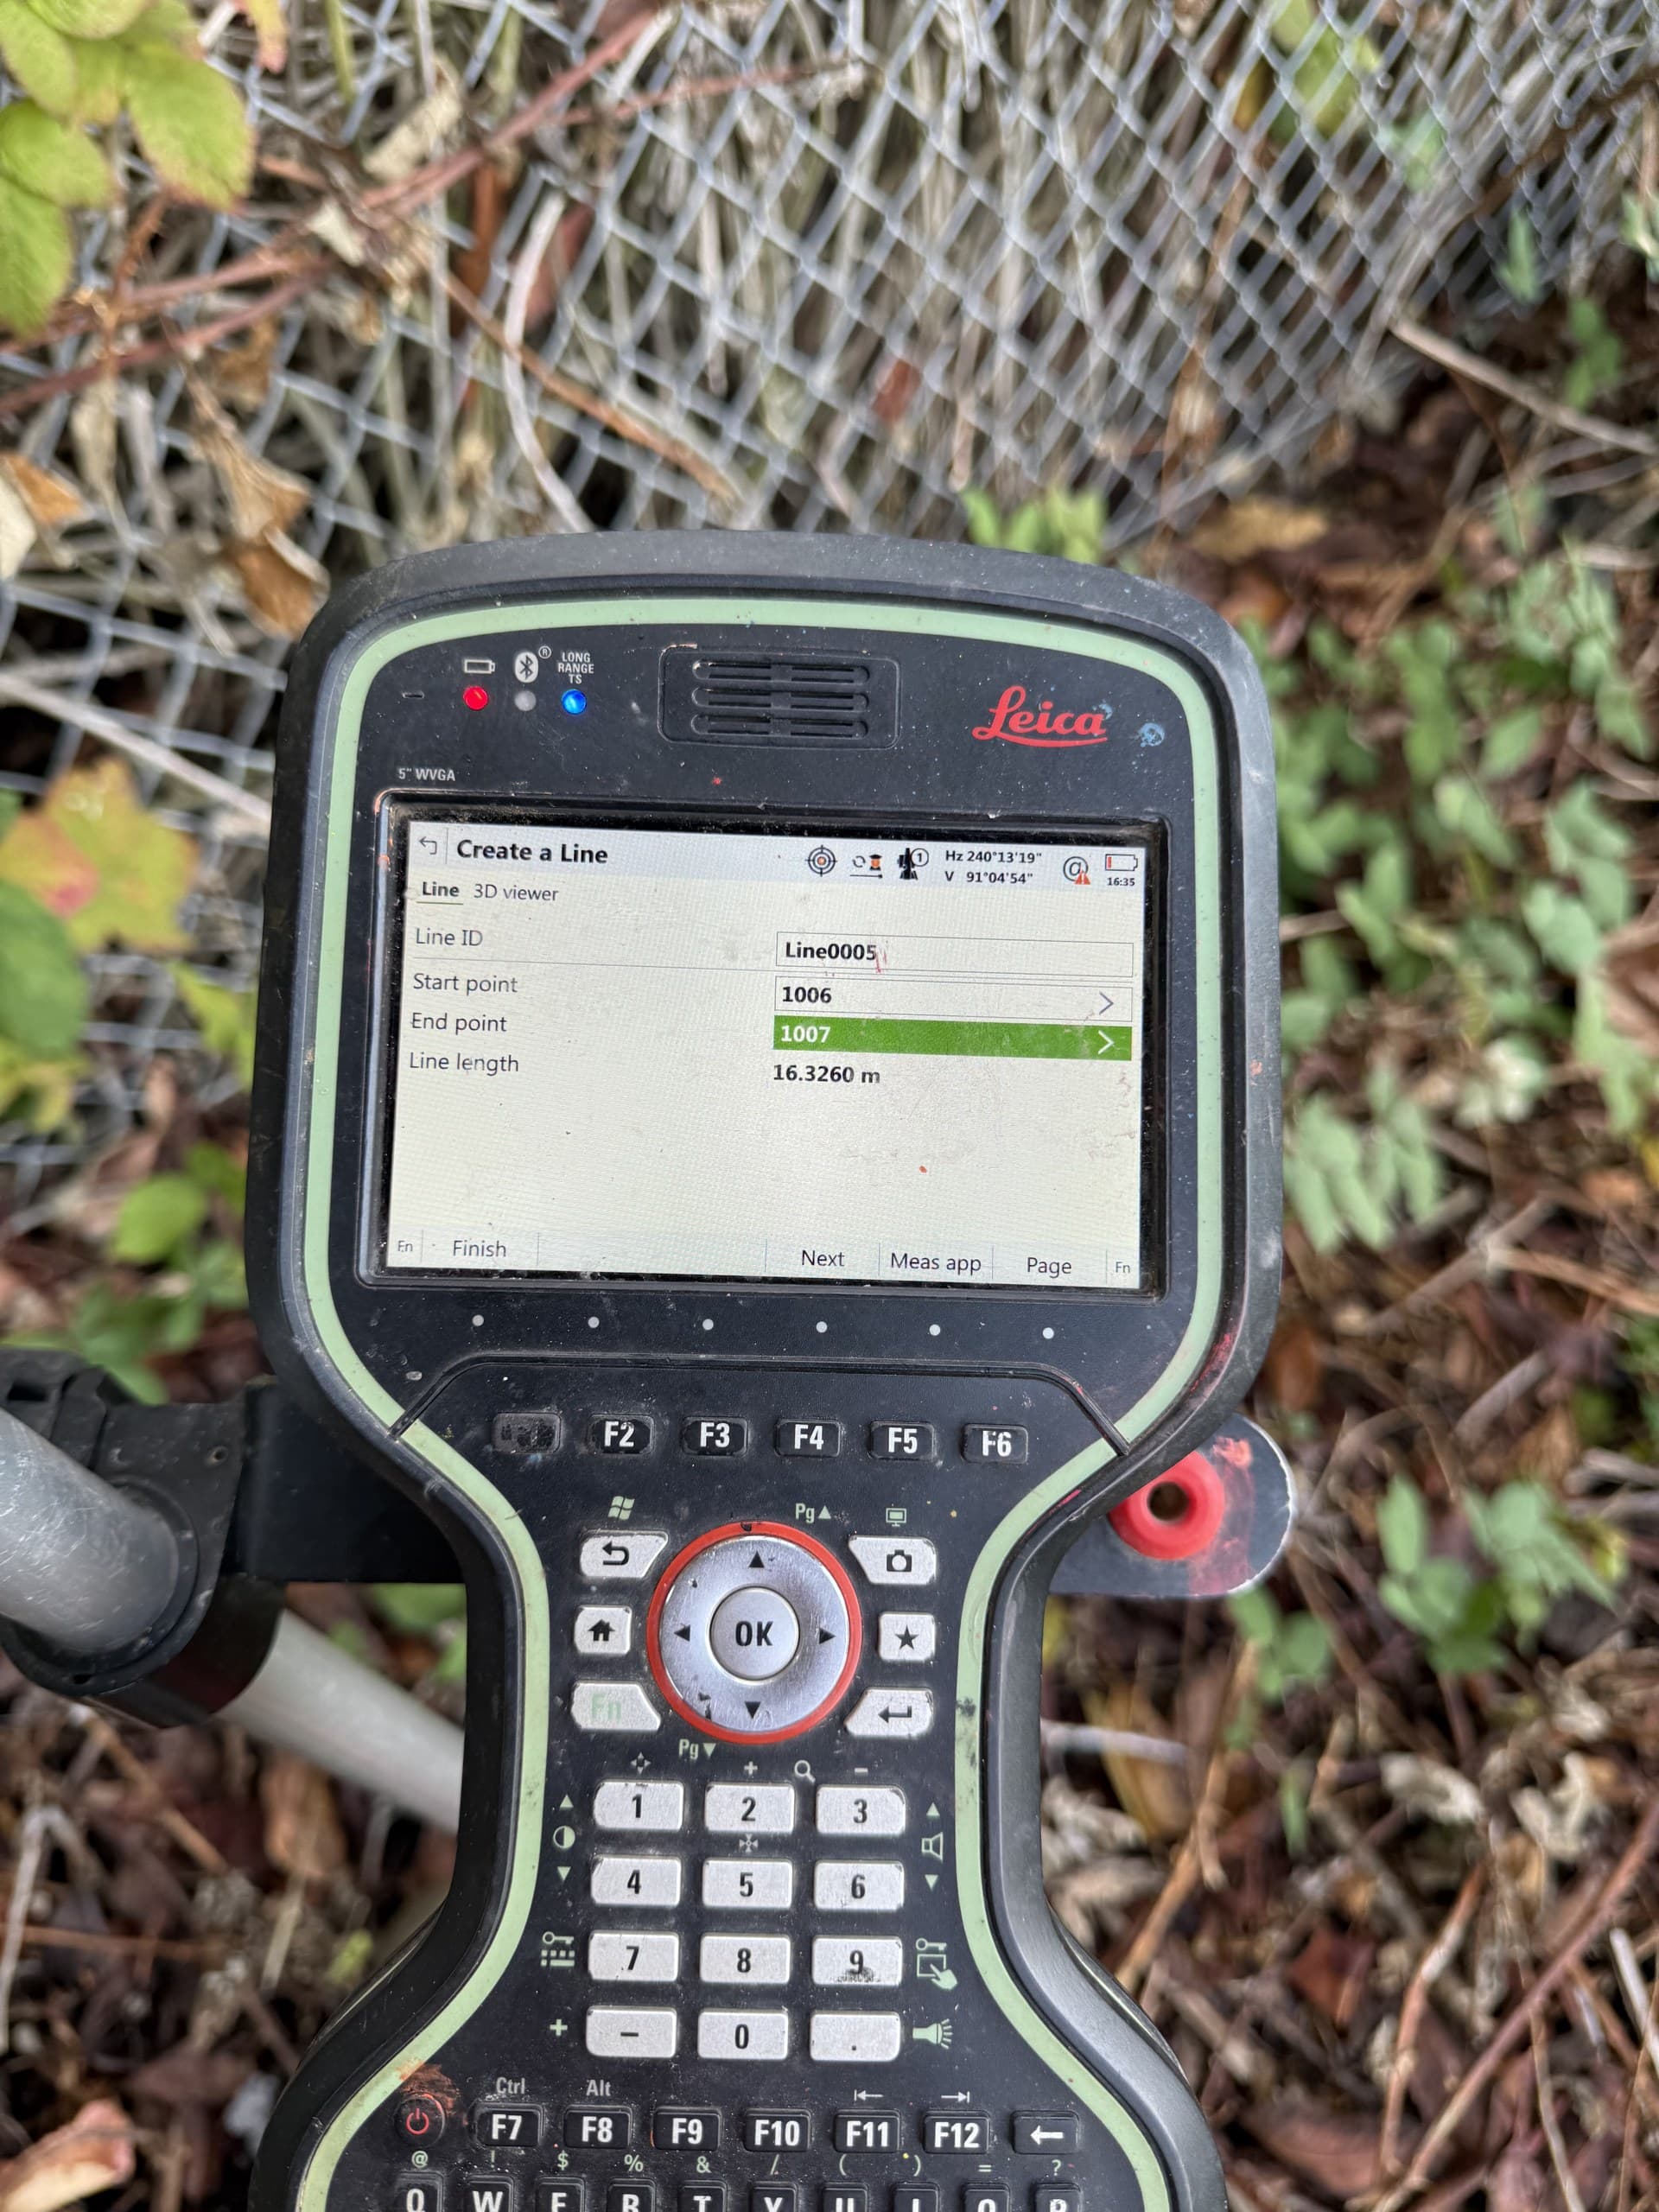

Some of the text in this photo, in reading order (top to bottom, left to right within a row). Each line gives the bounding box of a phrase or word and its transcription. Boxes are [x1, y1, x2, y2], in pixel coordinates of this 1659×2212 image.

[557, 663, 594, 674] RANGE
[562, 652, 591, 663] LONG
[569, 674, 582, 684] TS
[972, 686, 1108, 748] Leica
[416, 768, 456, 782] WVGA
[456, 838, 608, 863] Create a Line
[945, 850, 963, 862] Hz
[944, 871, 955, 882] V
[1107, 877, 1135, 887] 16:35
[422, 881, 559, 901] Line 3D viewer
[415, 927, 483, 946] Line ID
[785, 942, 876, 961] Line0005
[413, 973, 518, 995] Start point
[782, 986, 832, 1004] 1006
[411, 1012, 507, 1034] End point
[781, 1025, 830, 1044] 1007
[410, 1052, 519, 1077] Line length
[773, 1064, 880, 1084] 16.3260 m
[397, 1240, 413, 1253] Fn
[453, 1240, 507, 1258] Finish
[801, 1249, 845, 1268] Next
[890, 1252, 982, 1275] Meas app
[1027, 1256, 1072, 1279] Page
[1115, 1261, 1131, 1274] Fn
[605, 1421, 635, 1447] F2
[699, 1421, 731, 1448] F3
[794, 1424, 823, 1450] F4
[887, 1427, 918, 1454] F5
[982, 1430, 1012, 1457] F6
[795, 1503, 815, 1524] Pg
[734, 1621, 773, 1648] OK
[591, 1694, 622, 1720] Fn
[678, 1738, 698, 1760] Pg
[632, 1794, 643, 1818] 1
[741, 1796, 756, 1821] 2
[853, 1798, 868, 1824] 3
[626, 1870, 641, 1895] 4
[739, 1872, 753, 1897] 5
[850, 1873, 866, 1899] 6
[626, 1945, 639, 1971] 7
[736, 1948, 752, 1974] 8
[849, 1949, 864, 1974] 9
[734, 2024, 749, 2050] 0
[497, 2077, 525, 2095] Ctrl
[587, 2081, 611, 2097] Alt
[491, 2113, 522, 2140] F7
[582, 2116, 613, 2143] F8
[671, 2118, 703, 2145] F9
[754, 2119, 800, 2146] F10
[846, 2120, 889, 2147] F11
[934, 2121, 980, 2149] F12
[411, 2151, 429, 2168] @
[557, 2151, 569, 2171] $
[624, 2155, 644, 2172] %
[696, 2156, 711, 2173] &
[1052, 2160, 1062, 2176] ?
[406, 2188, 425, 2212] Q
[473, 2191, 504, 2212] W
[693, 2196, 712, 2212] T
